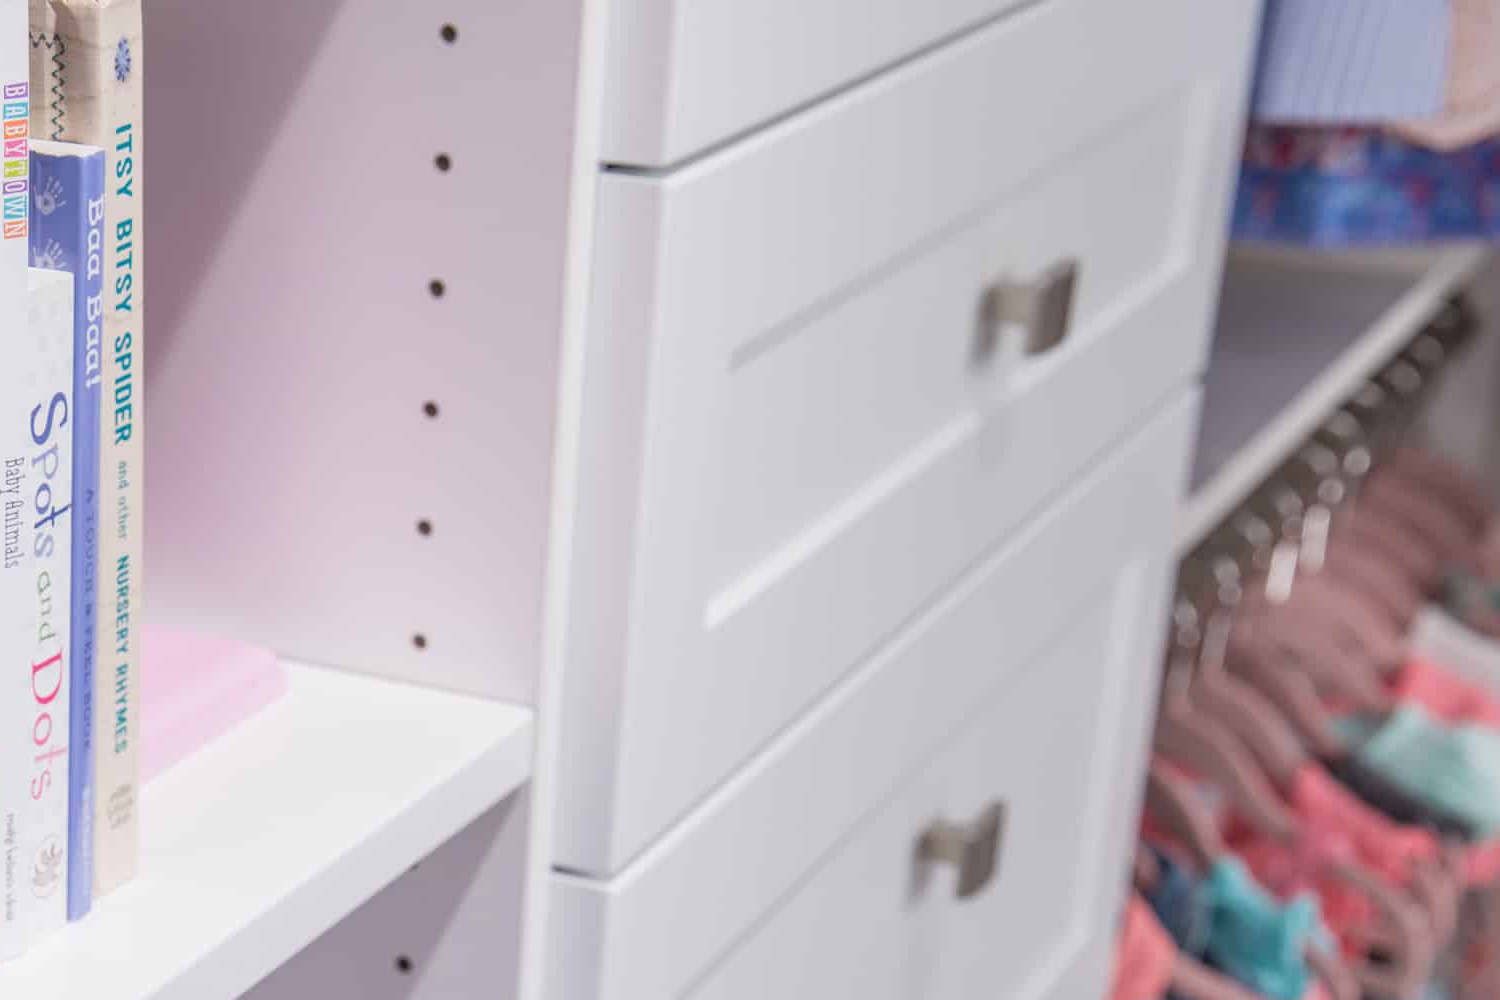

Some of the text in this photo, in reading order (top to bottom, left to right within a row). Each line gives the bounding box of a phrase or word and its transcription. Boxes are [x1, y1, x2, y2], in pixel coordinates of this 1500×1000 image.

[3, 82, 29, 240] BABYTOWN
[84, 193, 105, 389] Baa Baa!
[0, 456, 26, 569] Baby Animals
[114, 123, 133, 754] ITSY BITSY SPIDER and other NURSERY RHYMES
[29, 391, 72, 801] Spots and Dots
